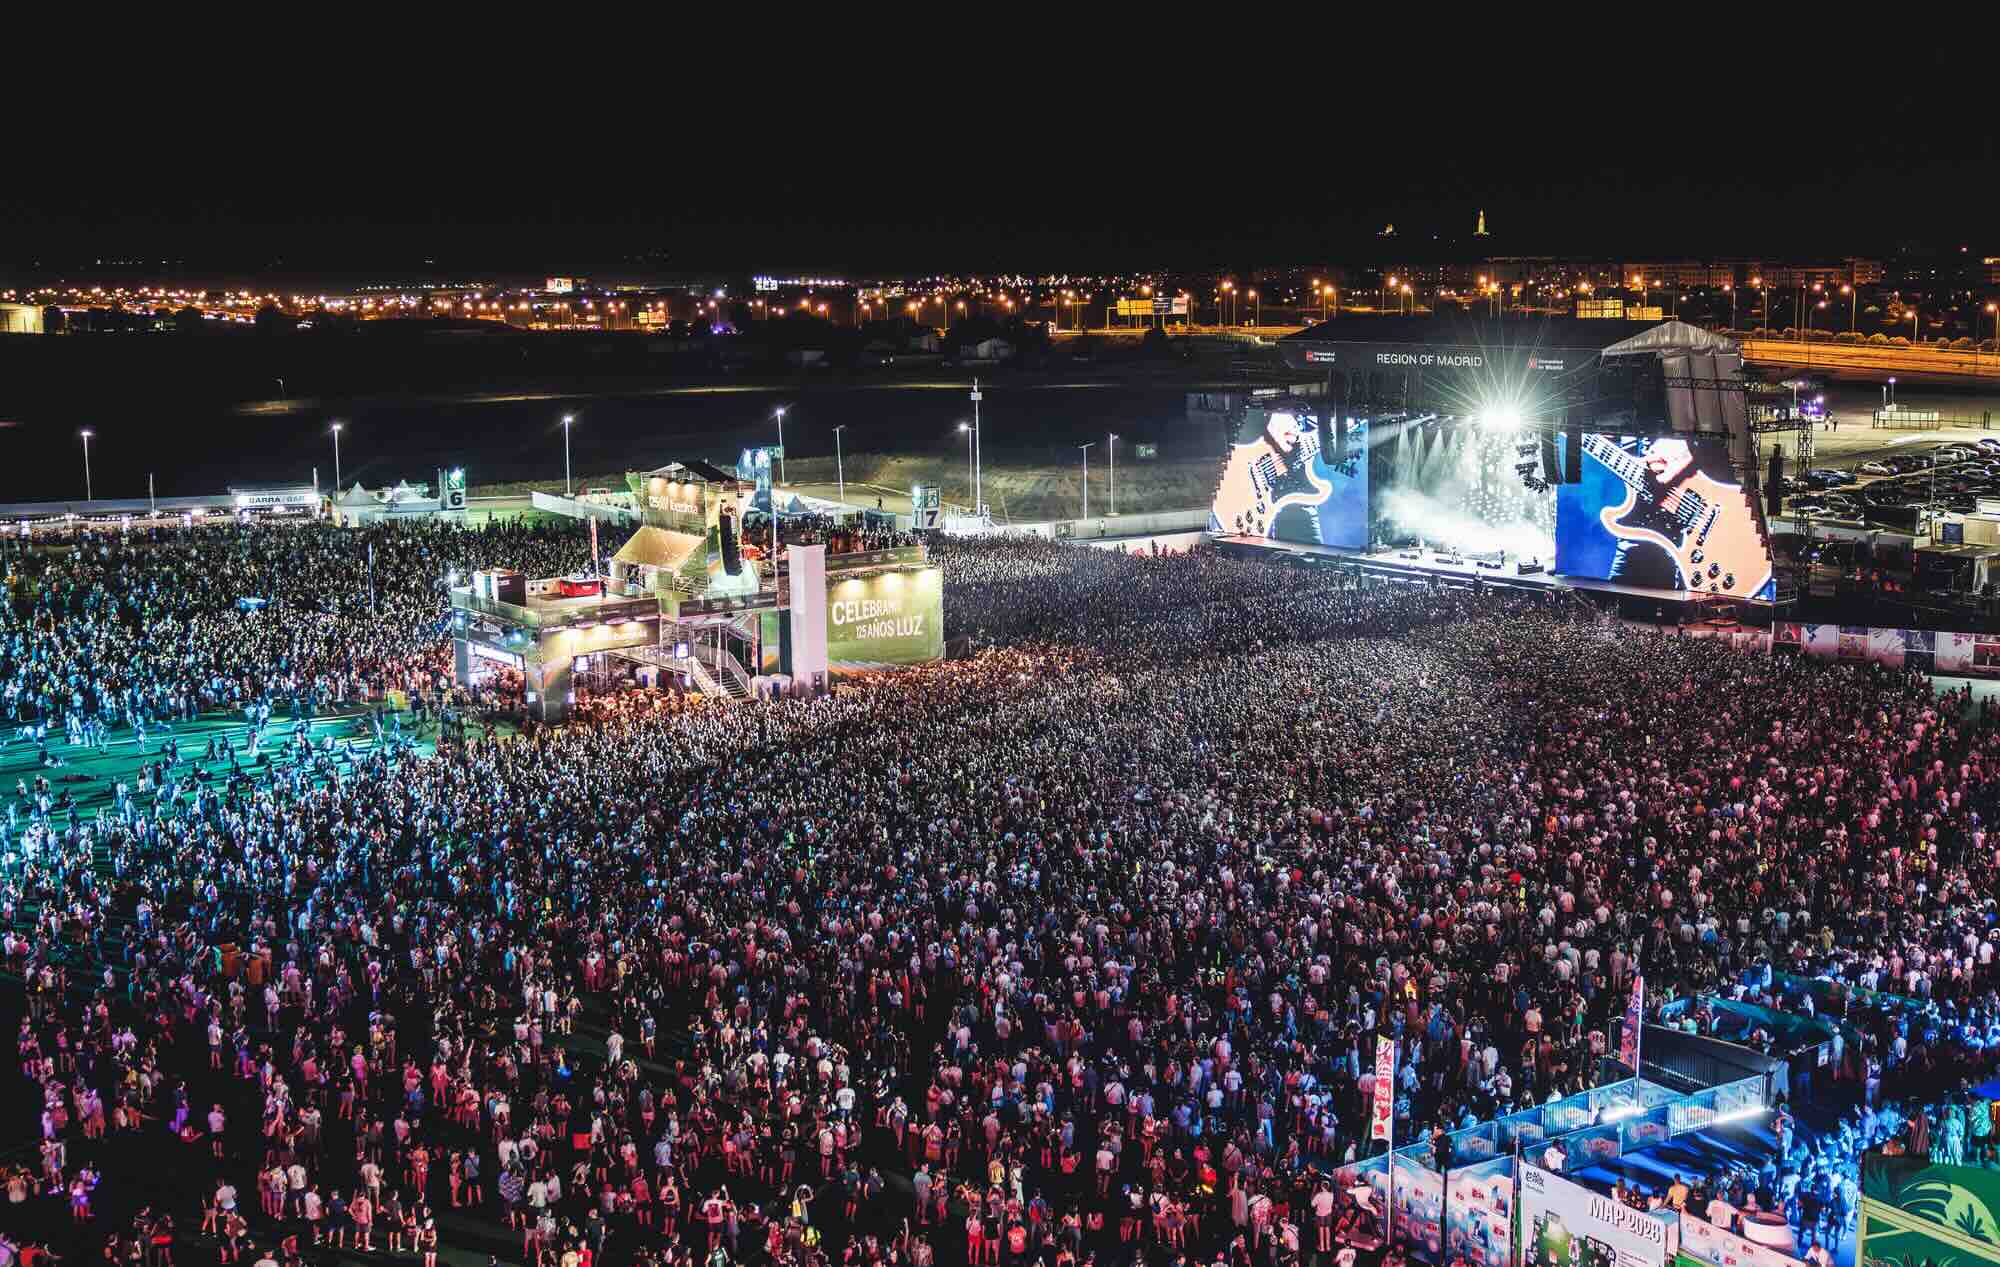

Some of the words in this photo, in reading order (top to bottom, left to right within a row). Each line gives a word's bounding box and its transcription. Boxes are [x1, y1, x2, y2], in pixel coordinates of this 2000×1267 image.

[1376, 353, 1417, 365] REGION
[1419, 354, 1434, 365] OF
[1437, 355, 1482, 366] MADRID
[450, 492, 463, 505] 6
[926, 510, 938, 526] 7
[867, 618, 895, 638] AÑOS
[896, 614, 922, 637] LUZ
[1591, 1198, 1625, 1227] MAP
